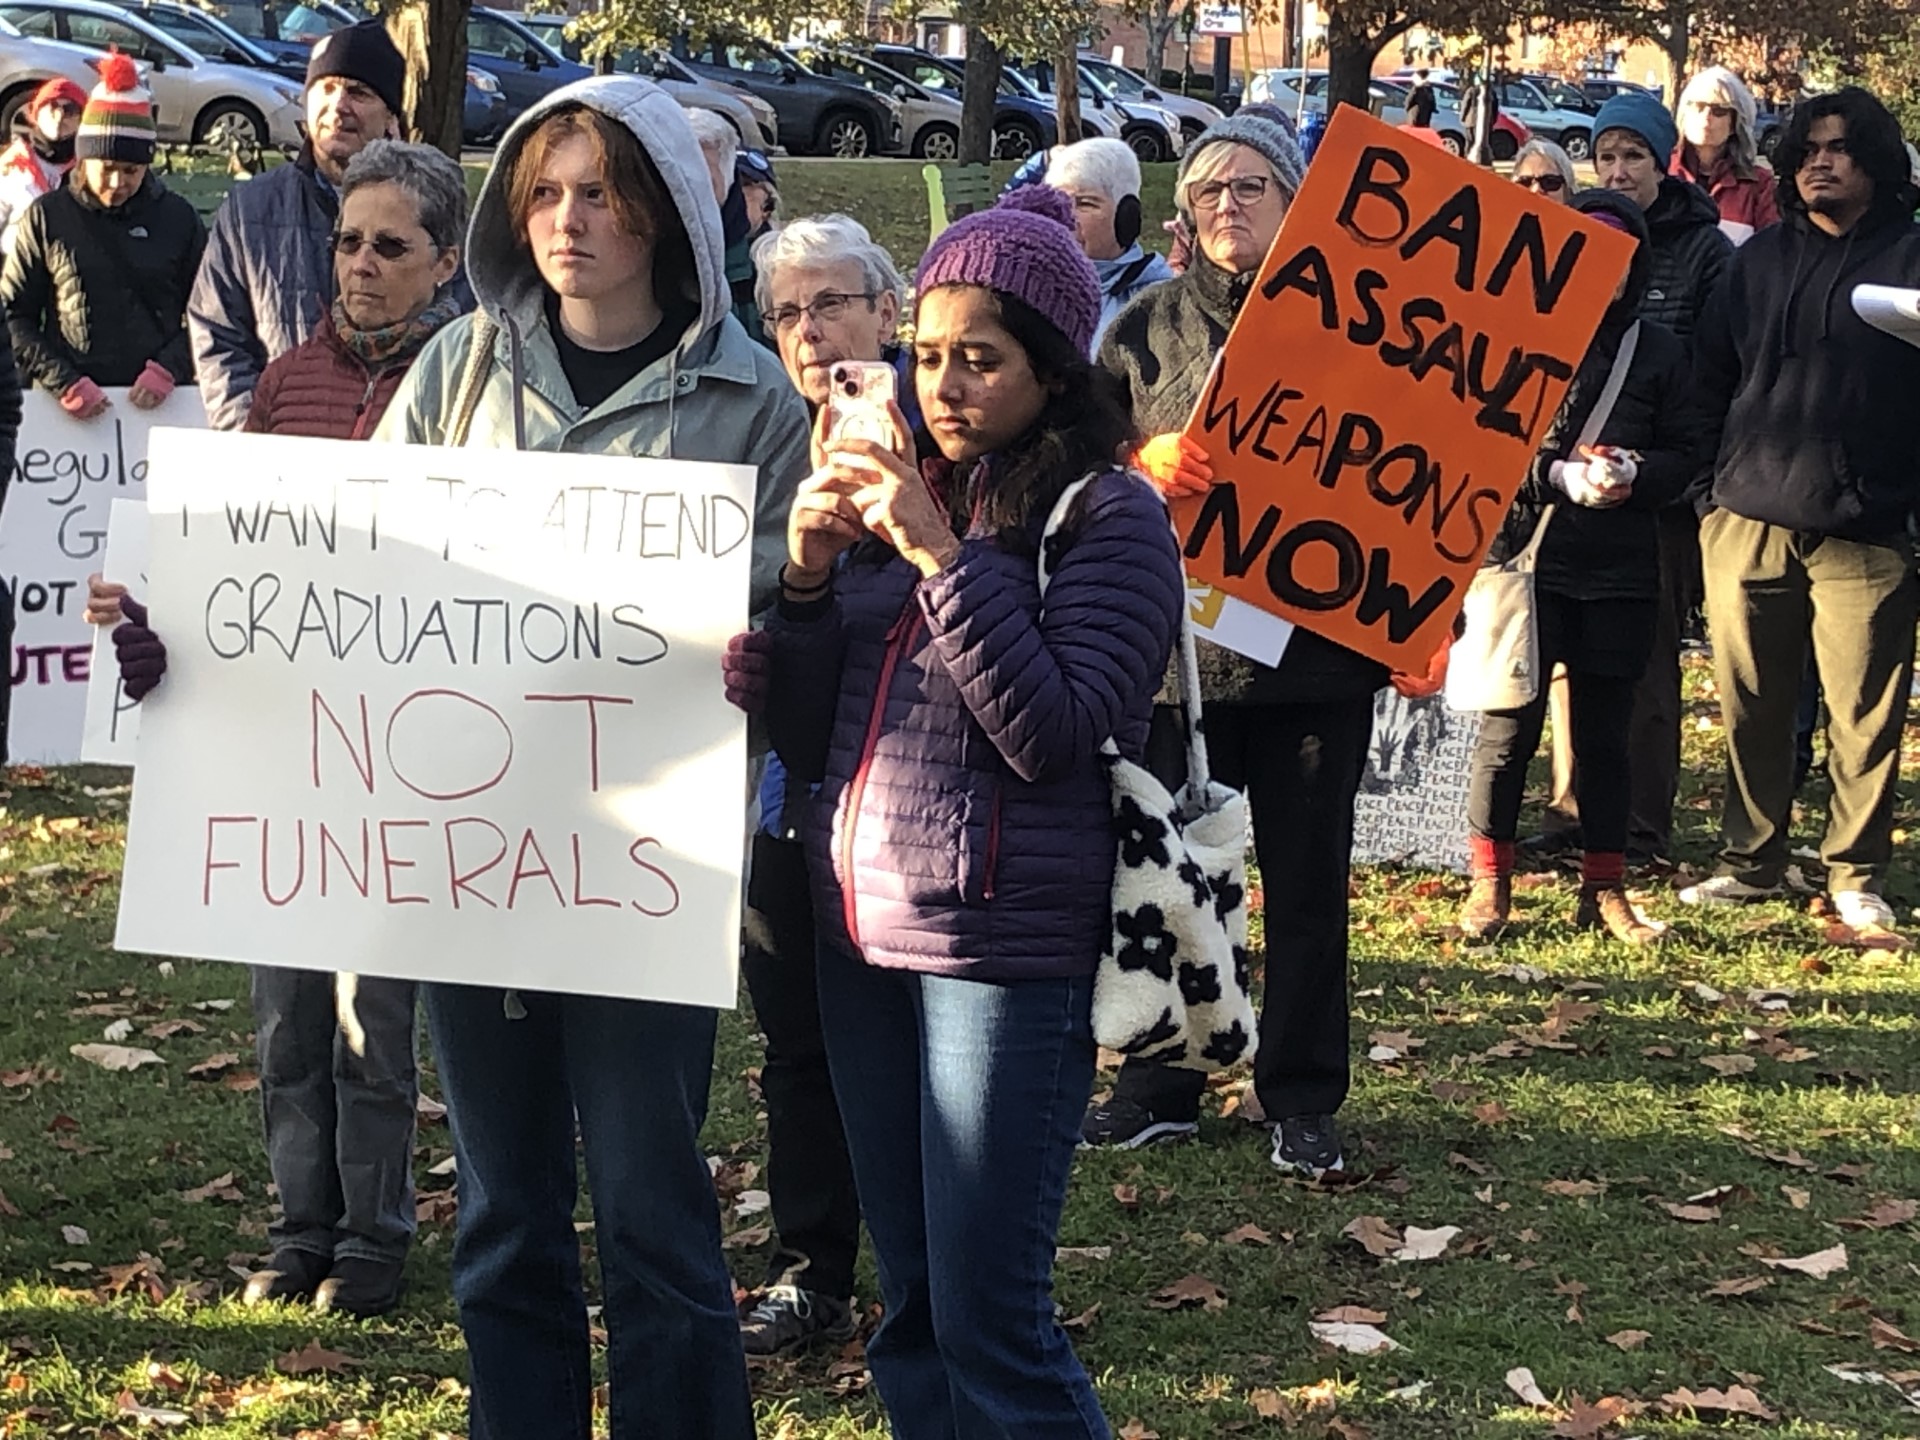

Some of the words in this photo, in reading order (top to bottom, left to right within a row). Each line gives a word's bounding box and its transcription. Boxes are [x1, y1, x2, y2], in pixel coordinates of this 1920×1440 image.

[1336, 146, 1585, 313] BAN
[1261, 246, 1572, 445] ASSAULT
[224, 476, 389, 554] WANT
[543, 486, 750, 560] ATTEND
[1203, 356, 1501, 564] WEAPONS
[205, 573, 669, 665] GRADUATIONS
[1183, 483, 1454, 643] NOW
[312, 688, 633, 800] NOT
[204, 815, 680, 917] FUNERALS
